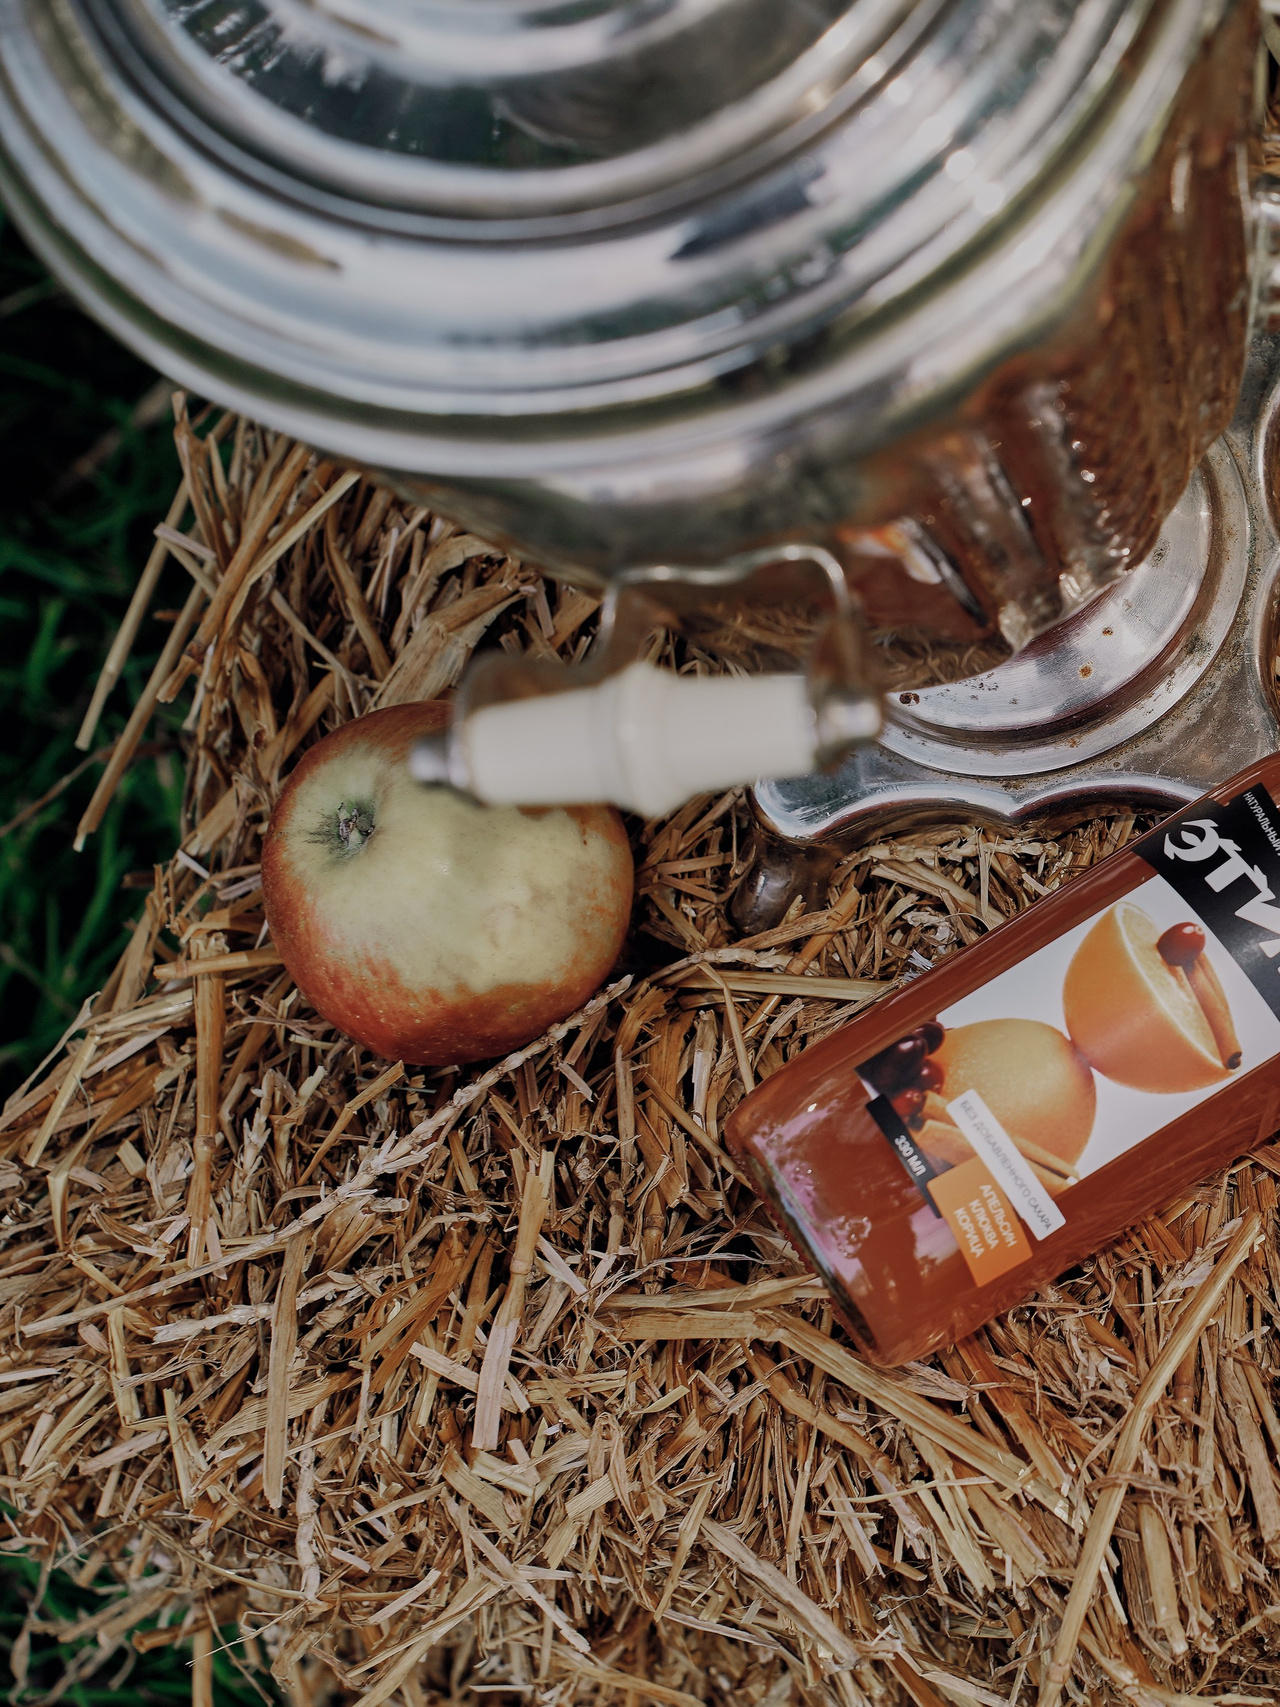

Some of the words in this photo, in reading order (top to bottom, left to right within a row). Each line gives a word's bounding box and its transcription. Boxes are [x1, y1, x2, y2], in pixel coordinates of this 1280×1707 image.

[894, 1134, 914, 1158] 330
[907, 1154, 927, 1177] МЛ
[960, 1100, 978, 1121] БЕЗ
[974, 1121, 1031, 1197] ДОБАВЛЕННОГО
[1028, 1196, 1053, 1230] САХАРА
[954, 1207, 985, 1258] КОРИЦА
[969, 1199, 1000, 1250] КЛЮКВА
[979, 1184, 1018, 1248] АПЕЛЬСИН
